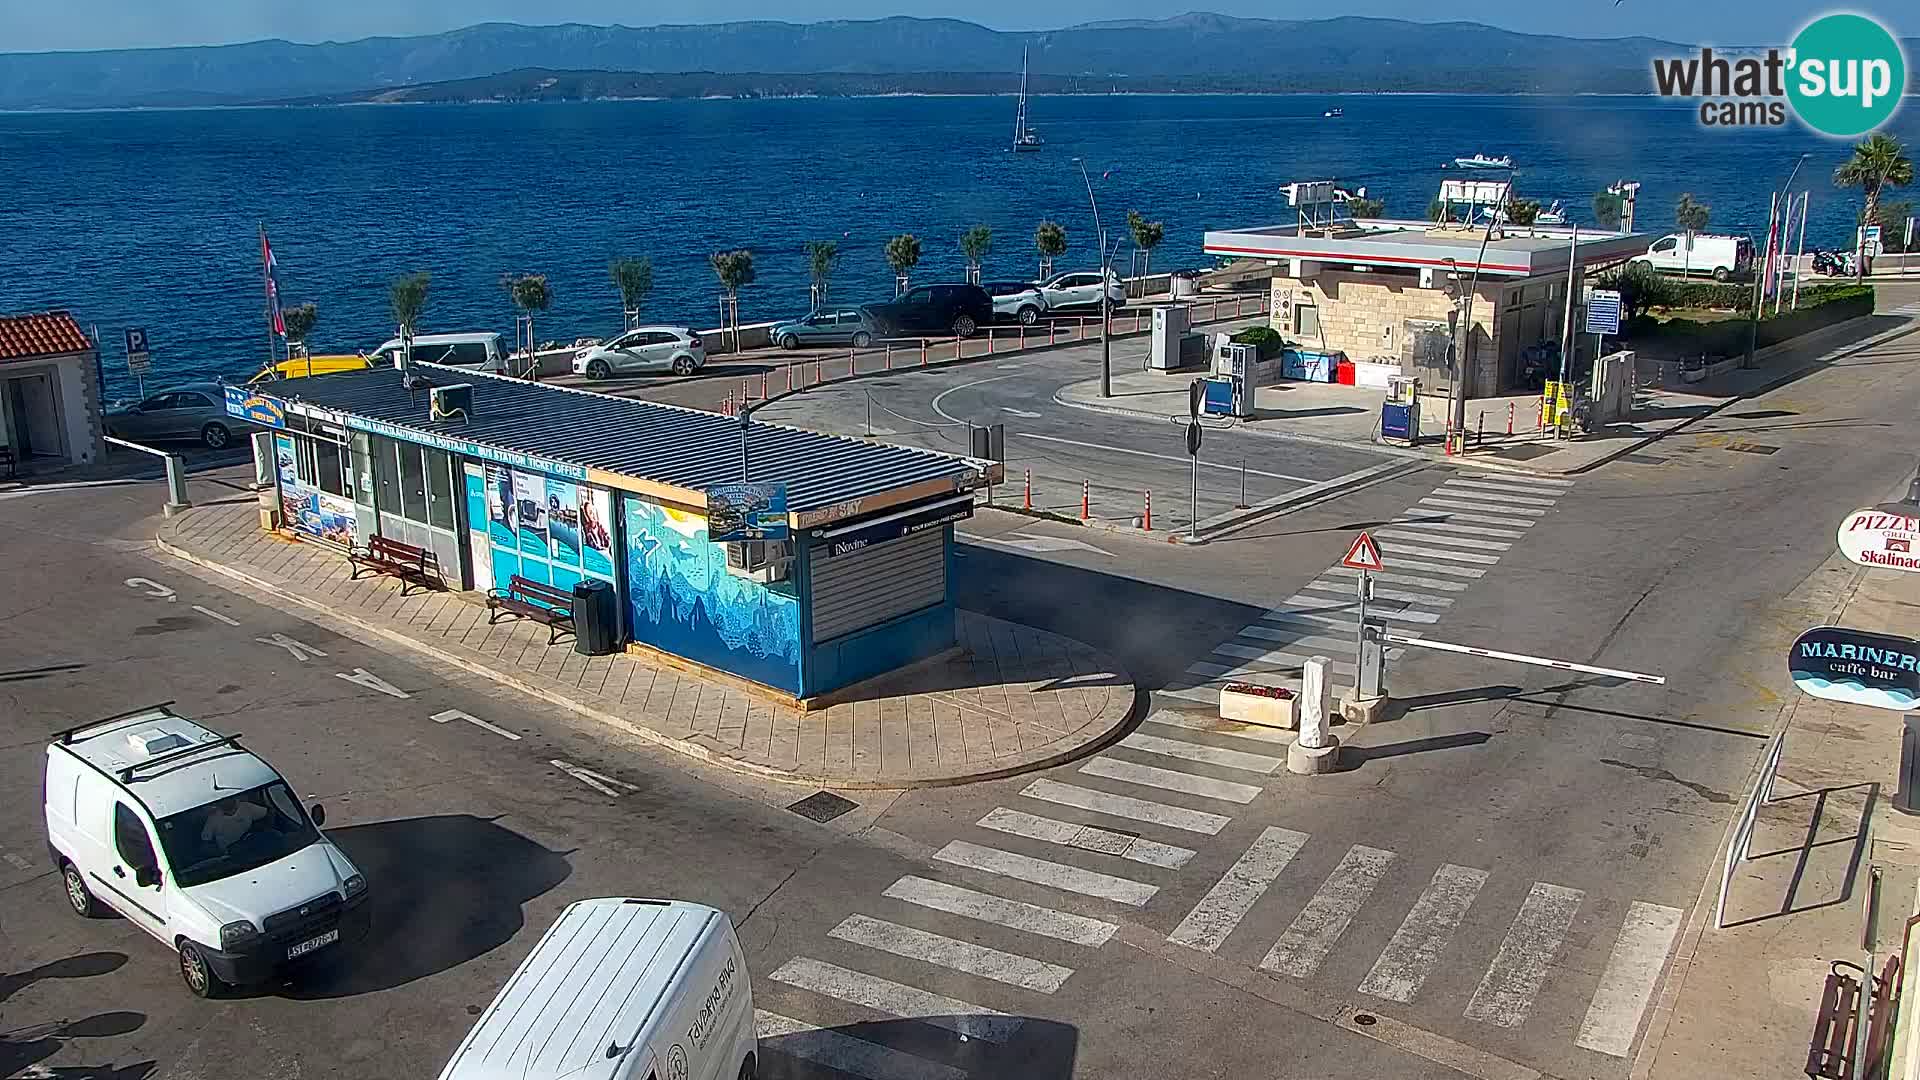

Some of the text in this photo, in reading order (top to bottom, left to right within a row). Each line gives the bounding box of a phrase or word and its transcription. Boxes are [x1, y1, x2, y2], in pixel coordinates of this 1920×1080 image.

[130, 331, 142, 350] P
[478, 447, 492, 459] BUS
[493, 450, 526, 466] STATION
[529, 458, 554, 473] TICKET
[555, 463, 582, 478] OFFICE
[1849, 515, 1920, 533] PIZZE
[1882, 531, 1918, 541] GRILL
[1829, 662, 1898, 680] caffe bar
